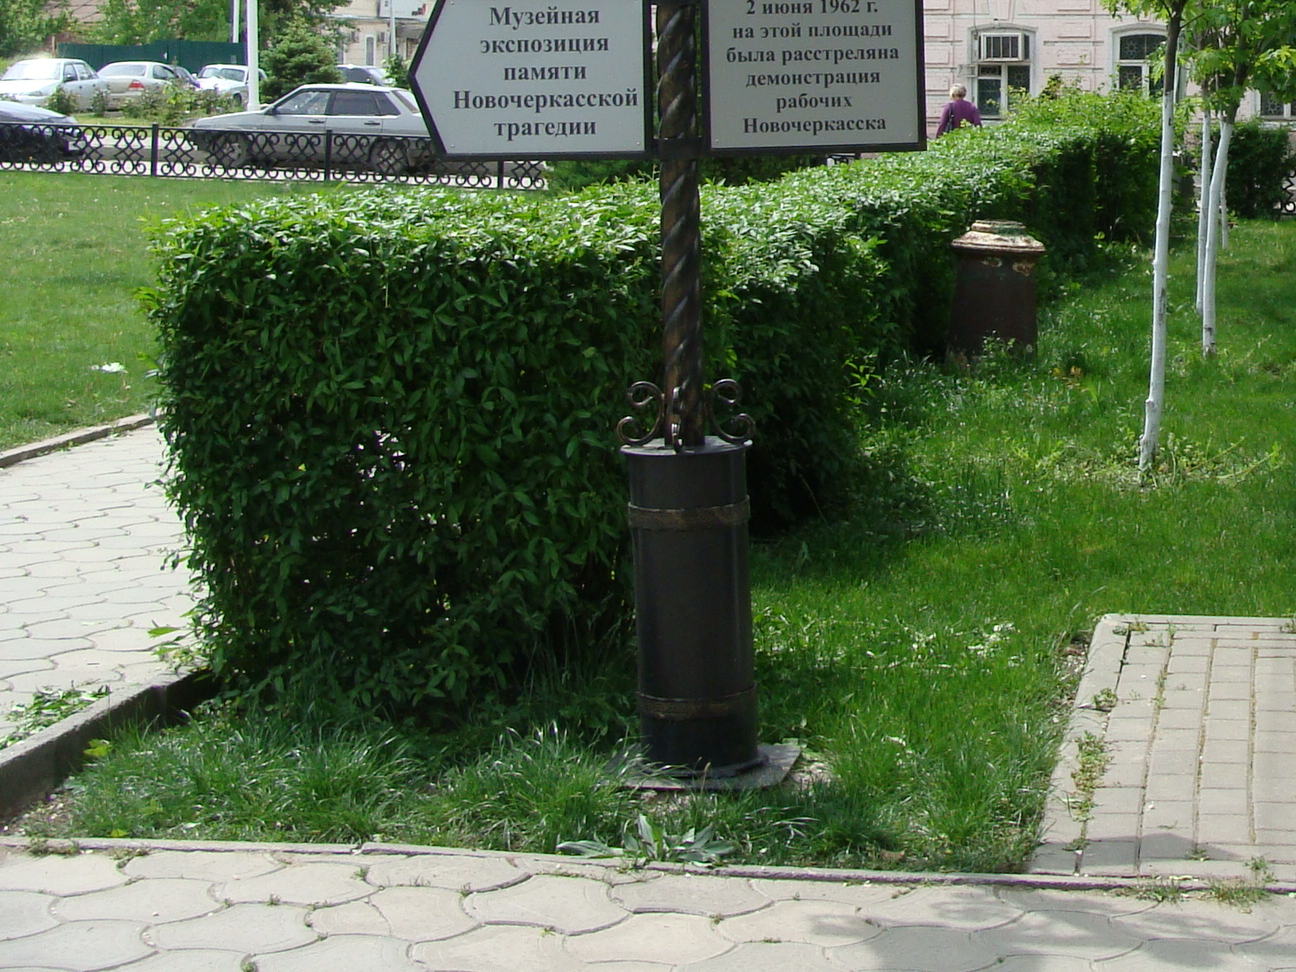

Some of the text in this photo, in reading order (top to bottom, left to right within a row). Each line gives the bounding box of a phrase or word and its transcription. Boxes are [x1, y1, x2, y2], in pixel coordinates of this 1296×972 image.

[746, 0, 756, 15] 2
[762, 2, 813, 15] июня
[866, 1, 878, 14] г.
[489, 6, 600, 30] Музейная
[733, 22, 892, 39] на этой площади
[480, 37, 609, 54] экспозиция
[726, 47, 899, 65] была расстреляна
[504, 66, 587, 81] памяти
[746, 71, 881, 88] демонстрация
[453, 88, 639, 113] Новочеркасской
[776, 93, 853, 113] рабочих
[494, 121, 597, 141] трагедии
[743, 118, 887, 136] Новочеркасска
